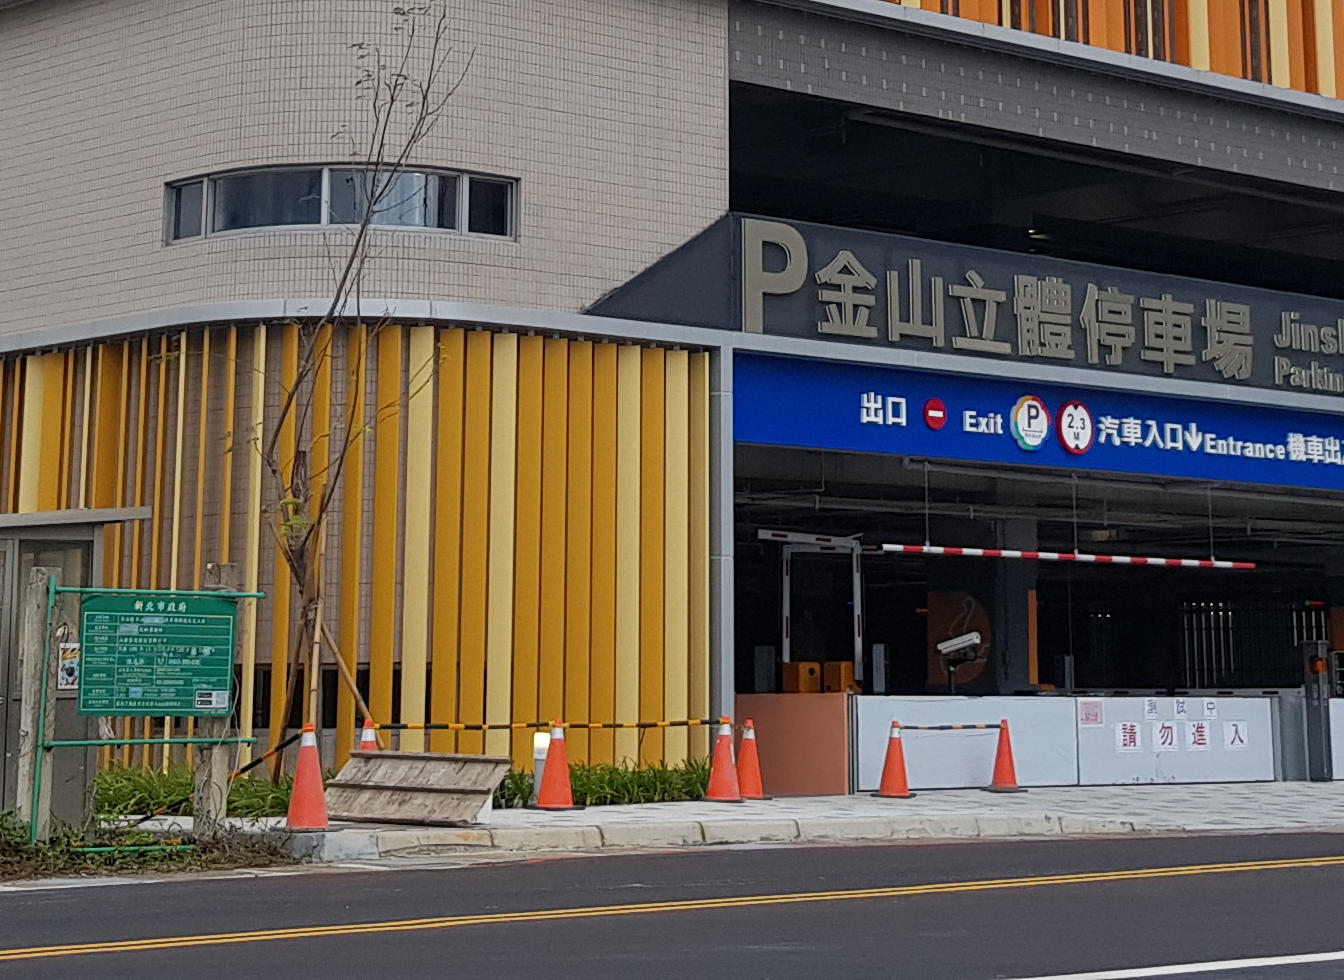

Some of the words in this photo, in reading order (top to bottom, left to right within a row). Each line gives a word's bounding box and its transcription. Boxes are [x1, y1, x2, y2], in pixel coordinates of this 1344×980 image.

[741, 218, 809, 333] P
[814, 249, 1254, 380] 金山立體停車場
[860, 391, 907, 427] 出口
[962, 410, 1003, 435] Exit
[1027, 404, 1040, 429] P
[1067, 414, 1086, 430] 2.3
[1098, 415, 1184, 451] 汽車入口
[1204, 433, 1286, 460] Entrance
[1122, 723, 1244, 747] 請勿進入
